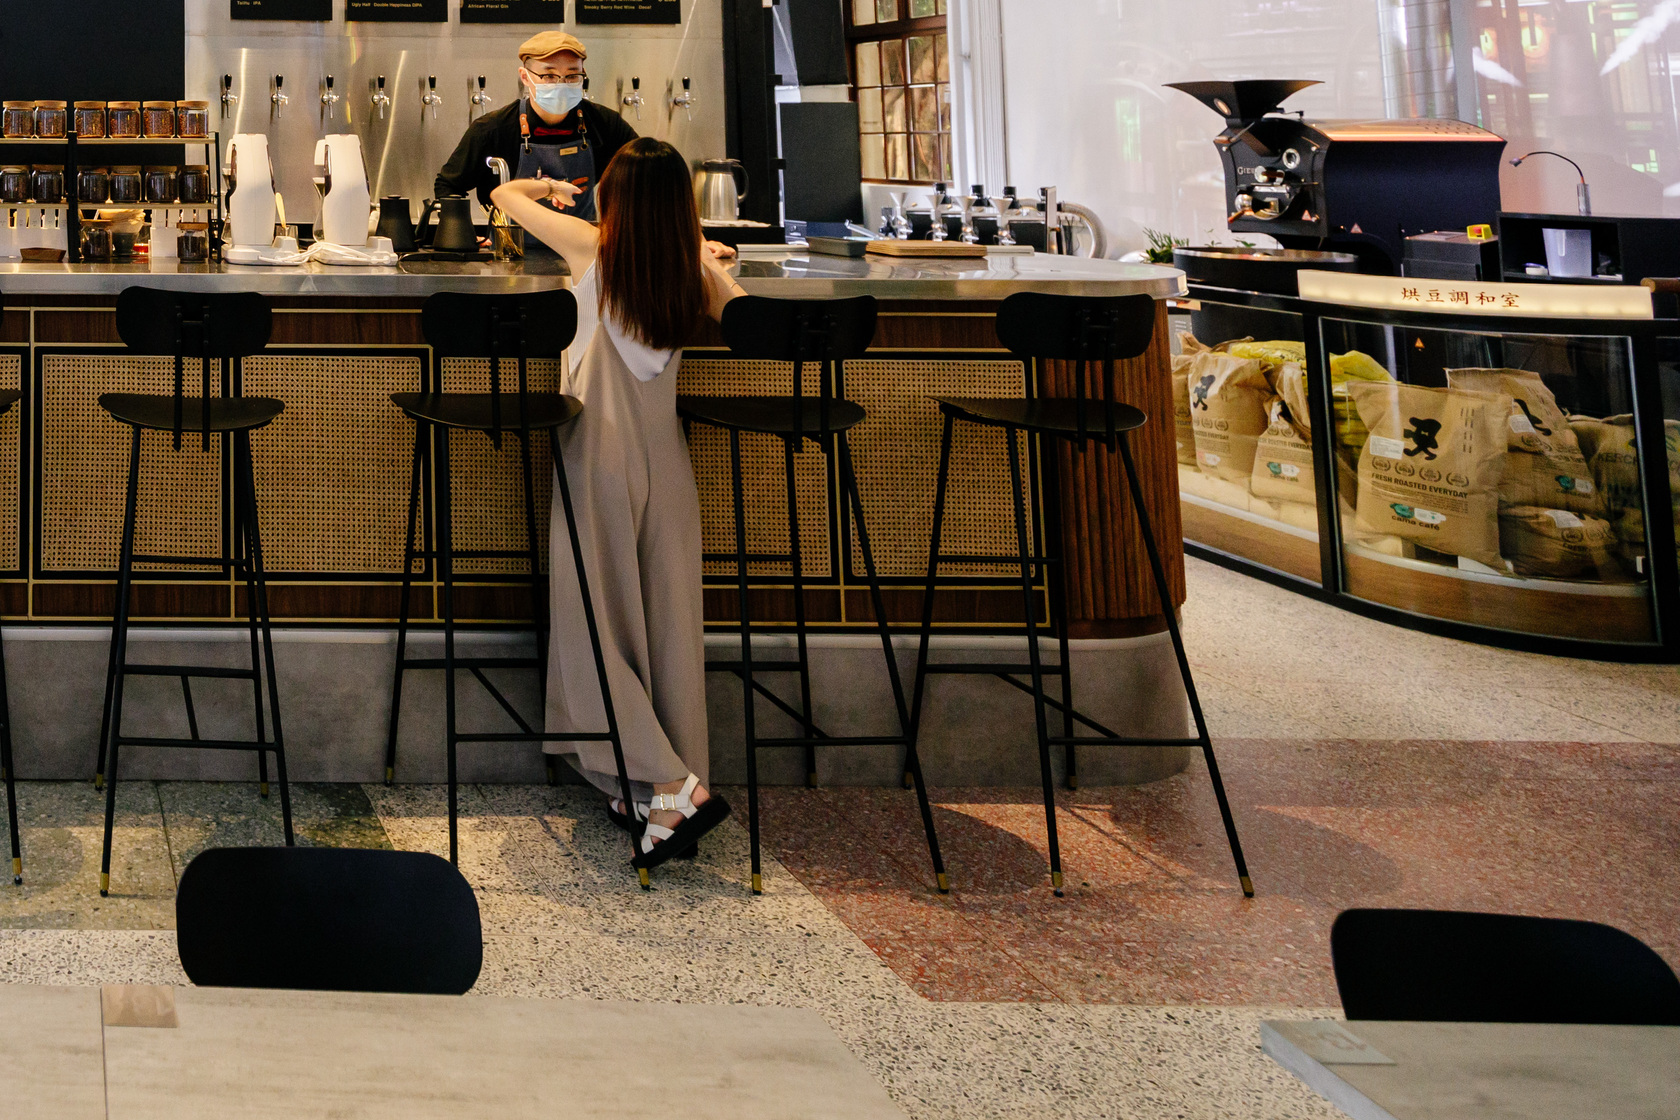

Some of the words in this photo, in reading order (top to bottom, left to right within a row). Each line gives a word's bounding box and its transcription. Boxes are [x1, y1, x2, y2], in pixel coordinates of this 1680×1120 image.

[1401, 287, 1520, 308] 烘豆調和室
[1371, 472, 1393, 483] FRESH
[1394, 478, 1427, 491] ROASTED
[1429, 485, 1468, 499] EVERYDAY
[1391, 515, 1417, 526] cama
[1418, 521, 1441, 531] café
